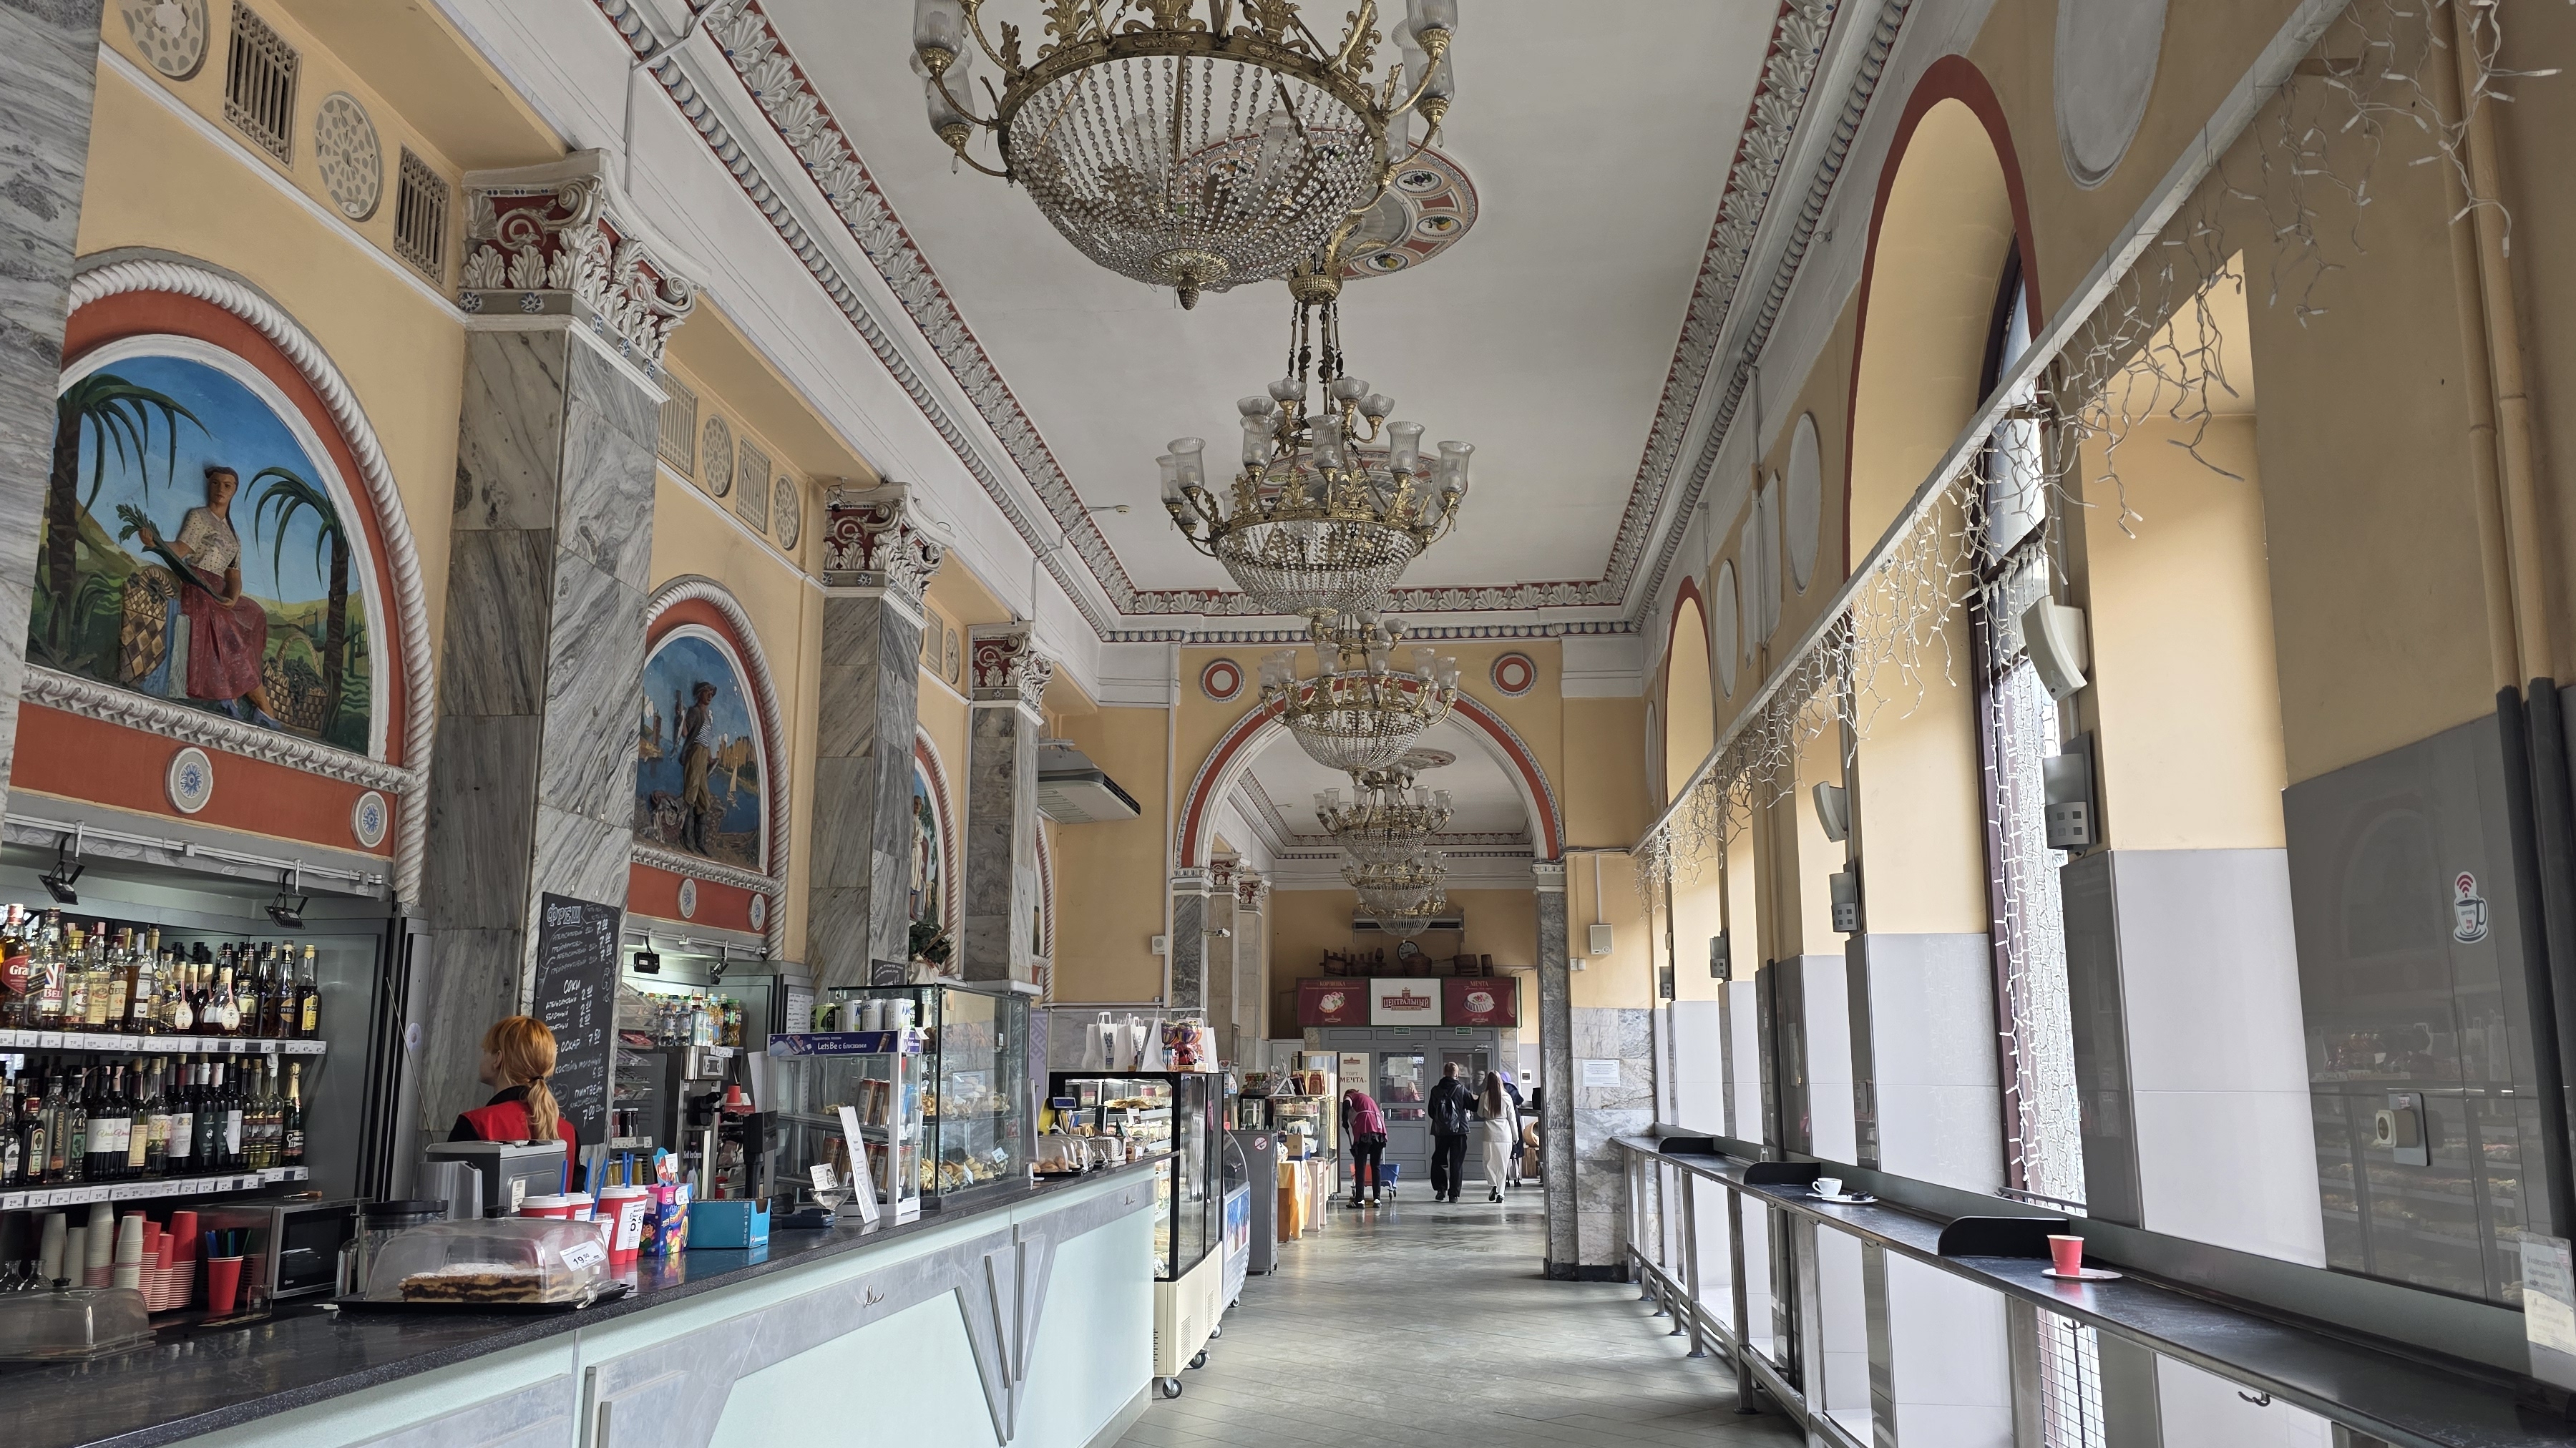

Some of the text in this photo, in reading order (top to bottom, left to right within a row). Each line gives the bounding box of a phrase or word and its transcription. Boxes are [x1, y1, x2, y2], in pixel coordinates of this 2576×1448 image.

[547, 904, 581, 926] ФРЕШ
[9, 965, 29, 975] Gra
[563, 979, 580, 994] СОКИ
[1384, 998, 1429, 1007] ЦЕНТРАЛЬНЫЙ
[572, 1253, 590, 1266] 19.50
